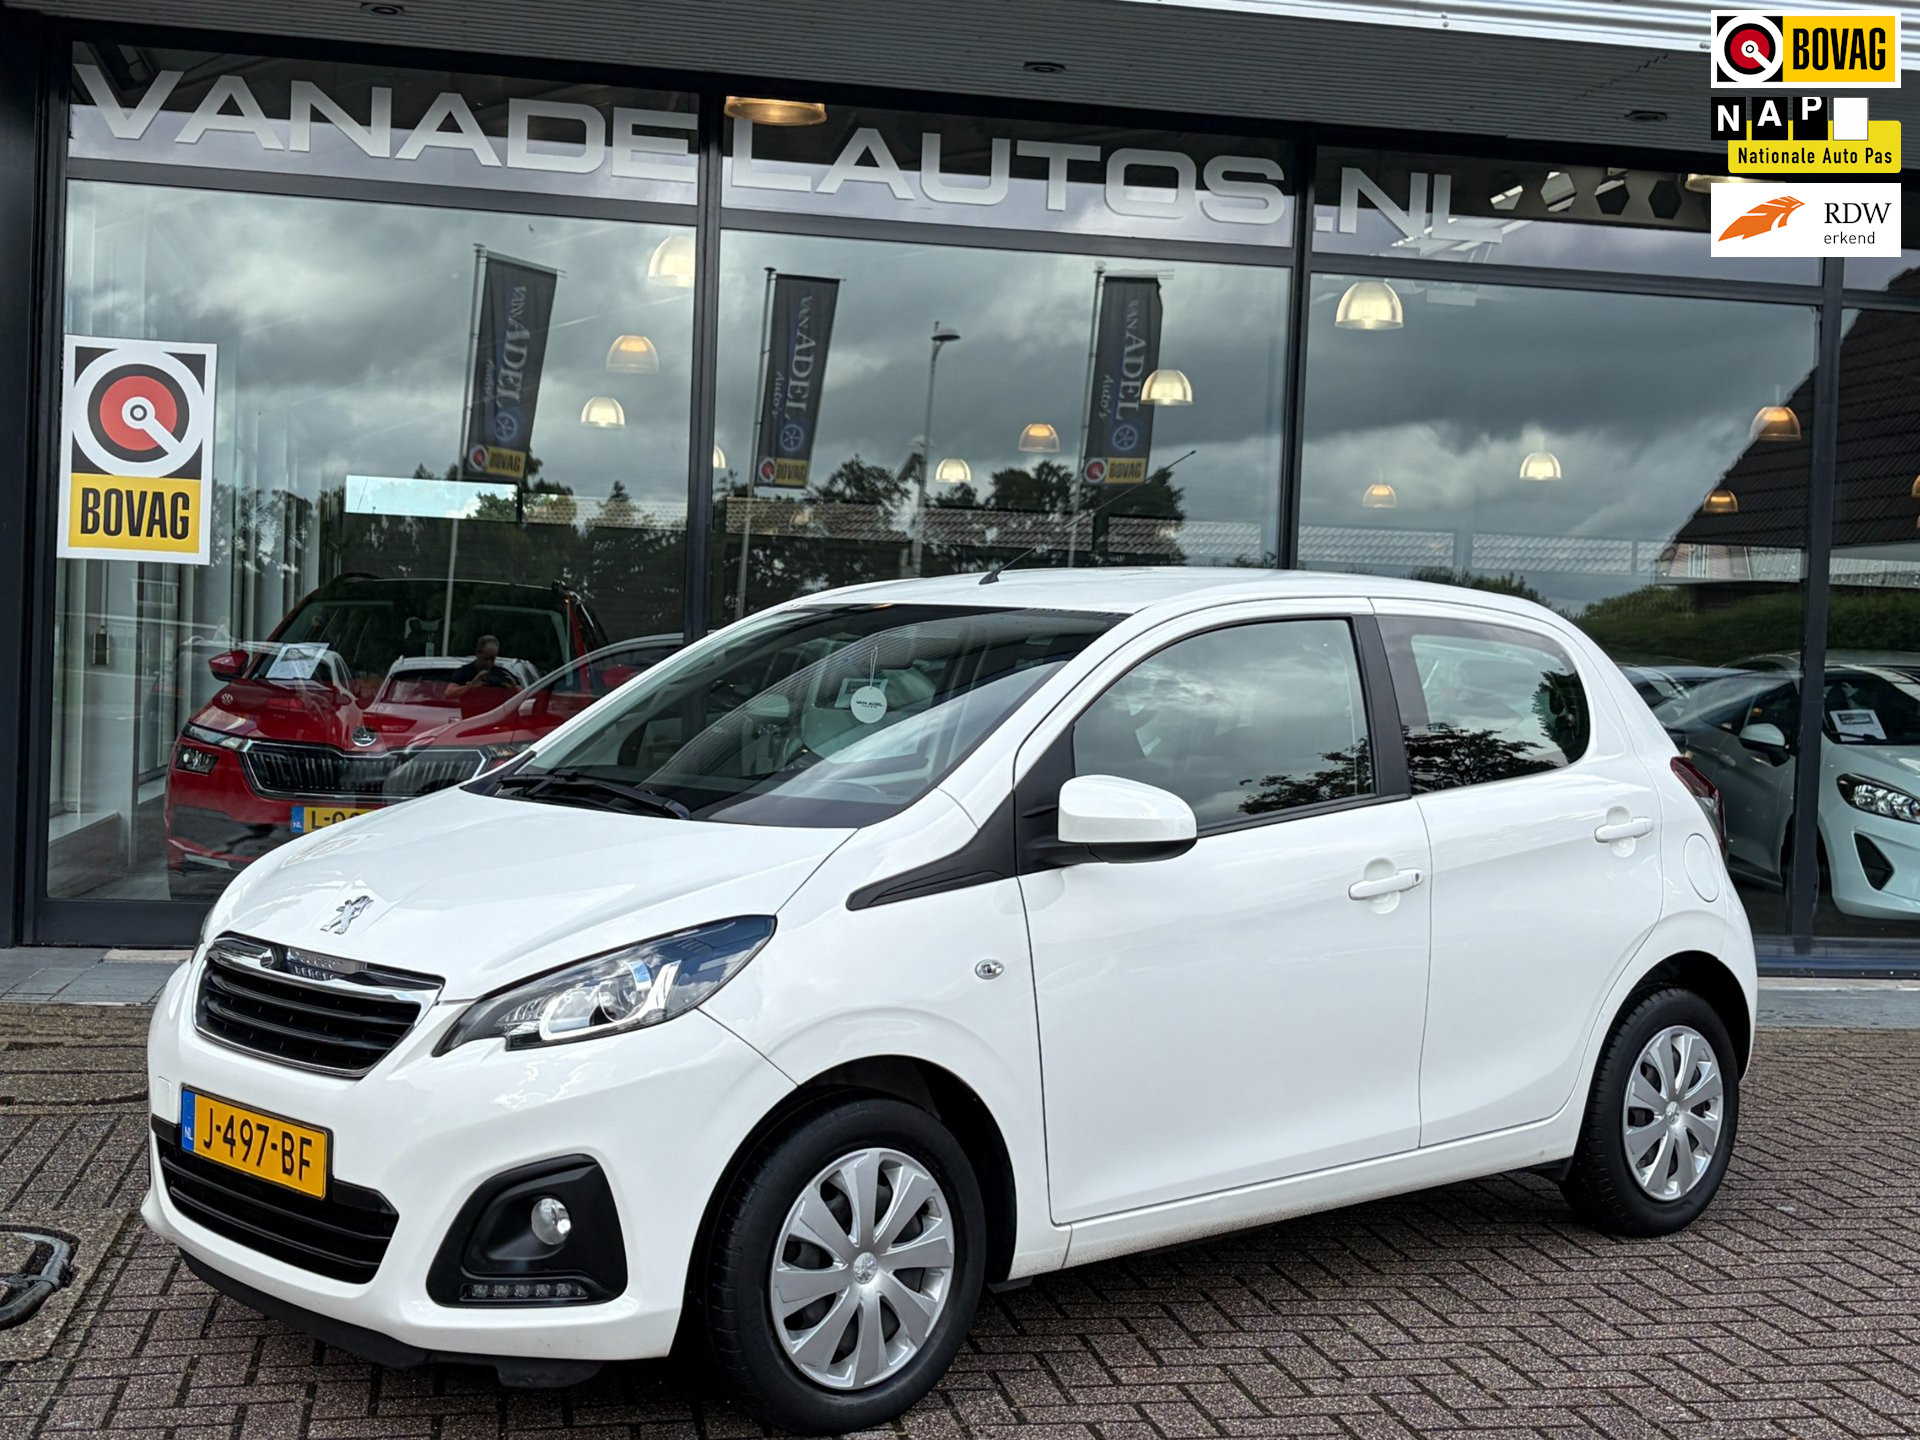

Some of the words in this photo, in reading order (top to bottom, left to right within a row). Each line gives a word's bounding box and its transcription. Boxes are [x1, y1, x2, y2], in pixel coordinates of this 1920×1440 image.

[785, 330, 817, 420] ADEL
[1115, 330, 1147, 421] ADEL
[80, 487, 190, 540] BOVAG
[184, 1126, 194, 1141] NL
[203, 1107, 313, 1181] J-497-BF
